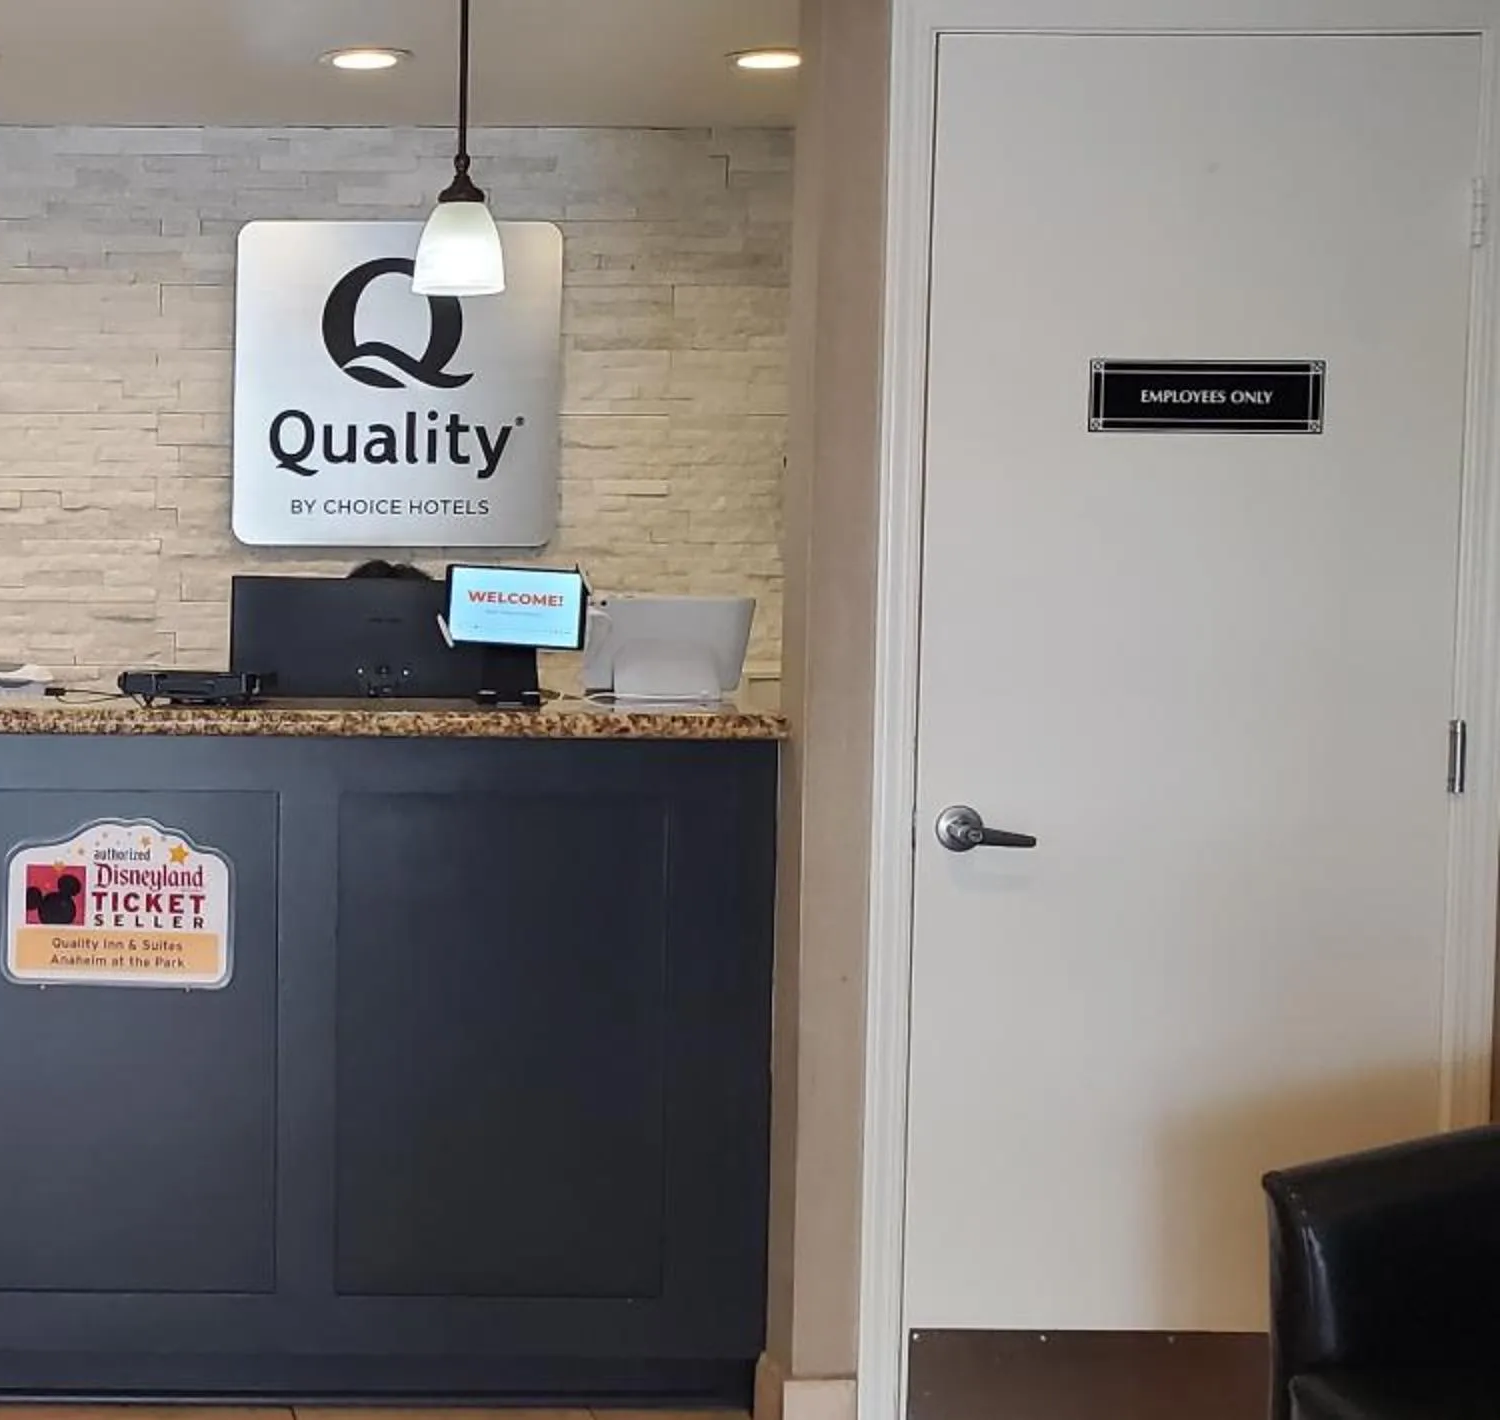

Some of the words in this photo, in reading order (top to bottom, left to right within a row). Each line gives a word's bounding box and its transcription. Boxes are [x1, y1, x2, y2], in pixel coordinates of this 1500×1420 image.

[321, 257, 474, 389] Q
[1140, 389, 1226, 404] EMPLOYEES
[1231, 390, 1273, 404] ONLY
[268, 409, 513, 479] Quality
[290, 499, 317, 515] BY
[323, 499, 403, 515] CHOICE
[409, 499, 490, 515] HOTELS
[467, 589, 565, 607] WELCOME!
[93, 847, 152, 861] authorized
[94, 862, 204, 891] Disneyland
[92, 891, 206, 915] TICKET
[94, 914, 205, 928] SELLER
[52, 937, 99, 950] Quality
[103, 938, 123, 949] Inn
[128, 939, 137, 950] &
[142, 939, 183, 951] Suites
[51, 954, 107, 966] Anaheim
[111, 955, 125, 967] at
[130, 955, 150, 968] the
[155, 956, 186, 969] Park
